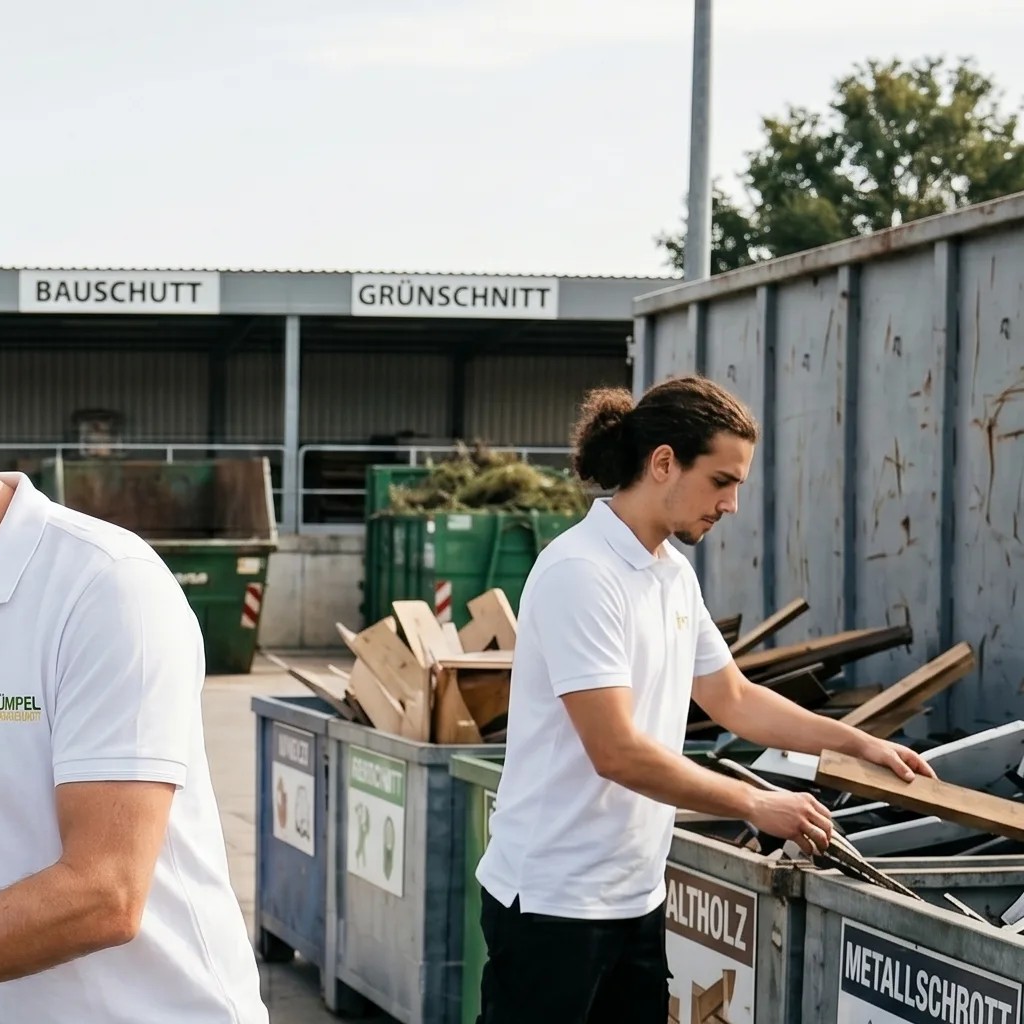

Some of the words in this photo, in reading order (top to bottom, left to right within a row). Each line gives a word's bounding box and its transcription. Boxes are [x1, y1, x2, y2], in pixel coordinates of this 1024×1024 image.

[36, 280, 203, 303] BAUSCHUTT
[358, 279, 551, 308] GRÜNSCHNITT
[666, 879, 747, 951] ALTHOLZ
